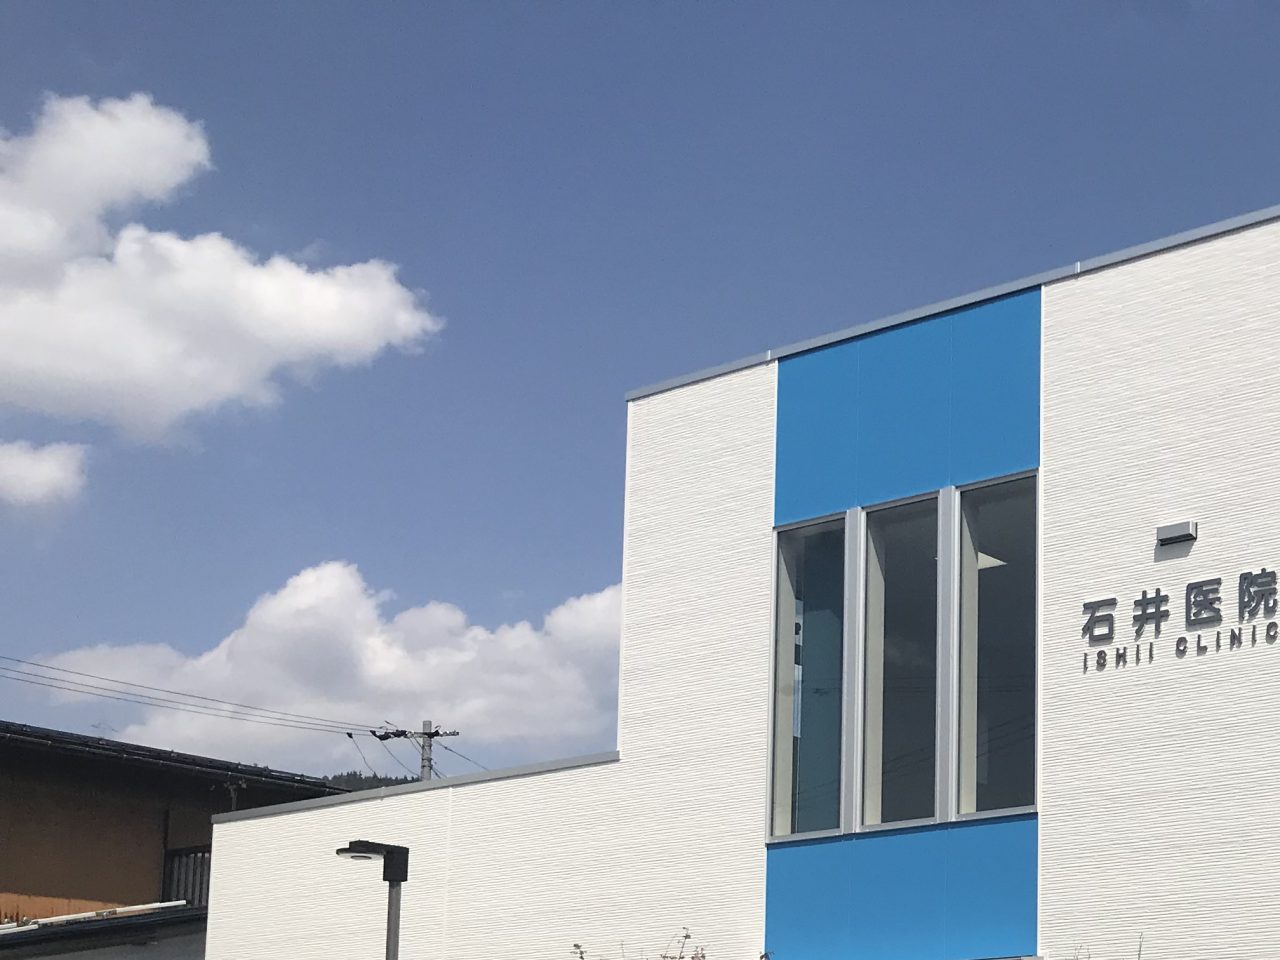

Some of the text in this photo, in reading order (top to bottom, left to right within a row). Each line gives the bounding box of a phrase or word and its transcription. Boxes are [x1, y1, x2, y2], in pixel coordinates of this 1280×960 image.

[1081, 567, 1278, 643] 石井医院
[1082, 621, 1279, 673] ISHII CLINIC
